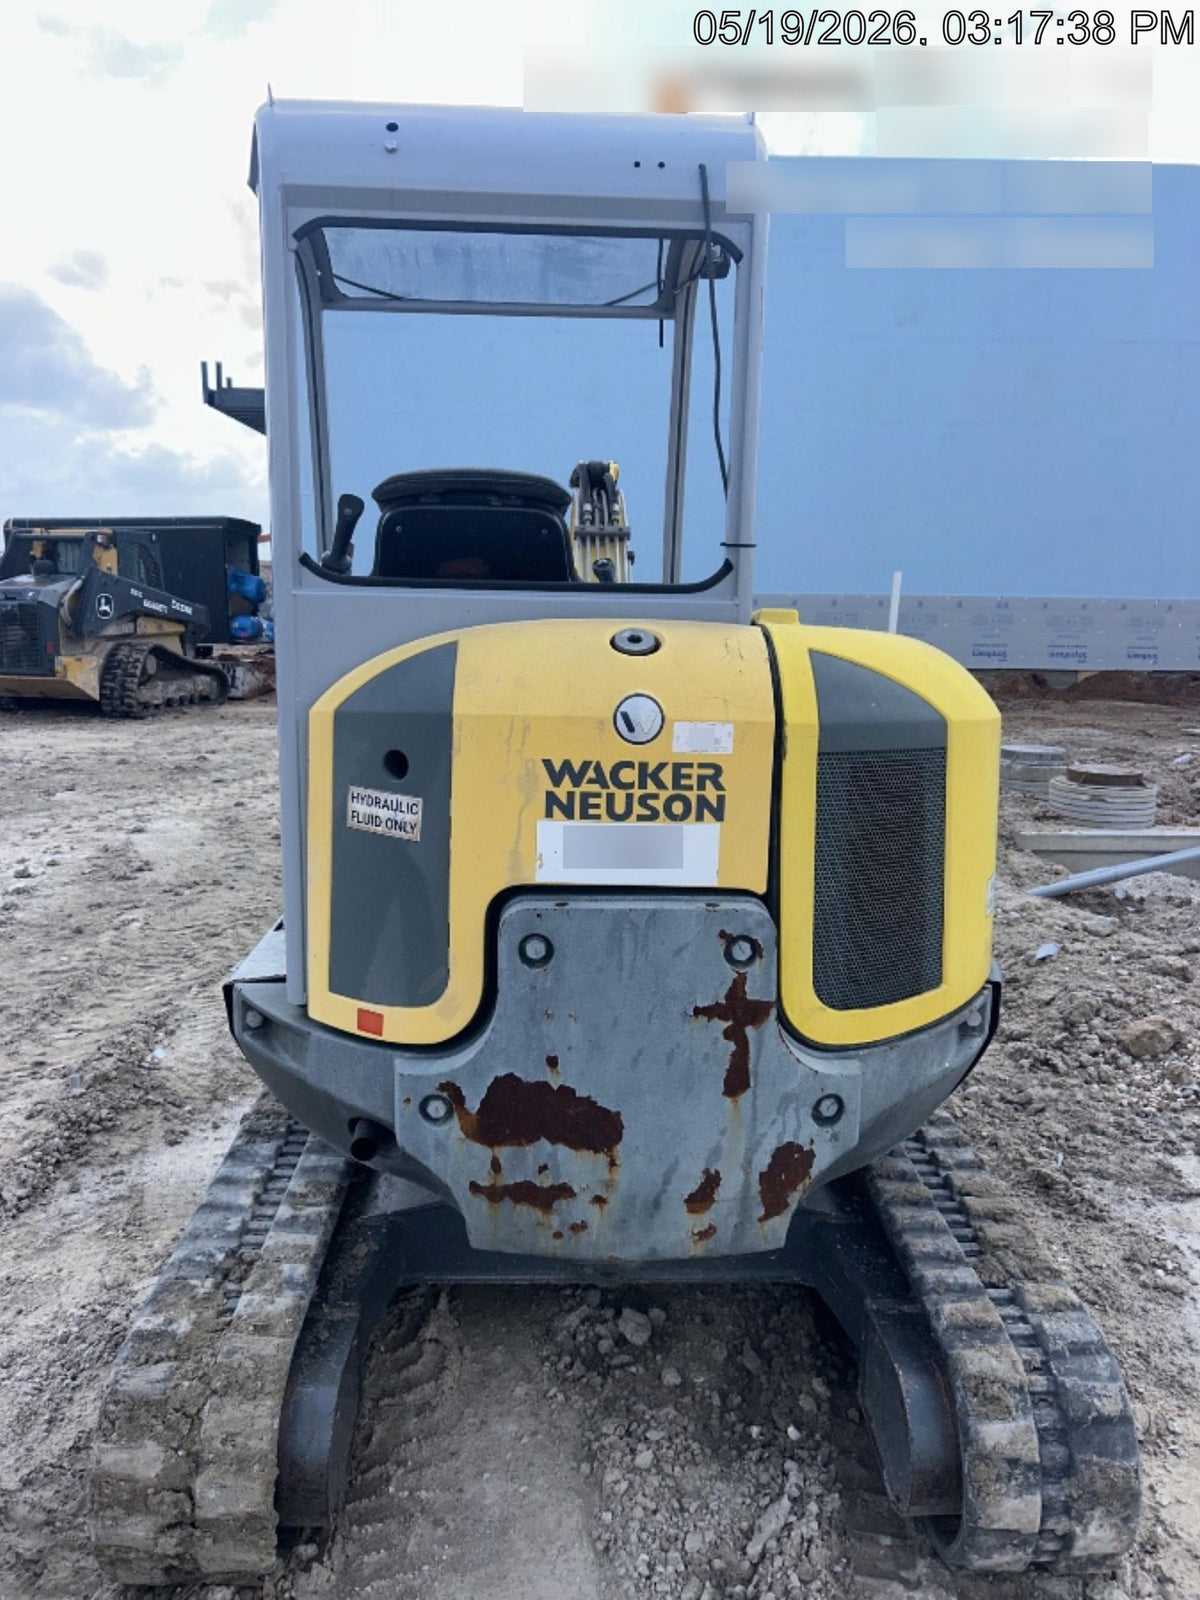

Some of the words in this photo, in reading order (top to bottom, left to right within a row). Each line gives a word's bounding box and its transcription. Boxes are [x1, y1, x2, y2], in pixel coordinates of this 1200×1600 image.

[541, 758, 726, 791] WACKER
[351, 791, 418, 814] HYDRAULIC
[544, 791, 726, 822] NEUSON
[351, 810, 382, 827] FLUID
[385, 817, 416, 833] ONLY
